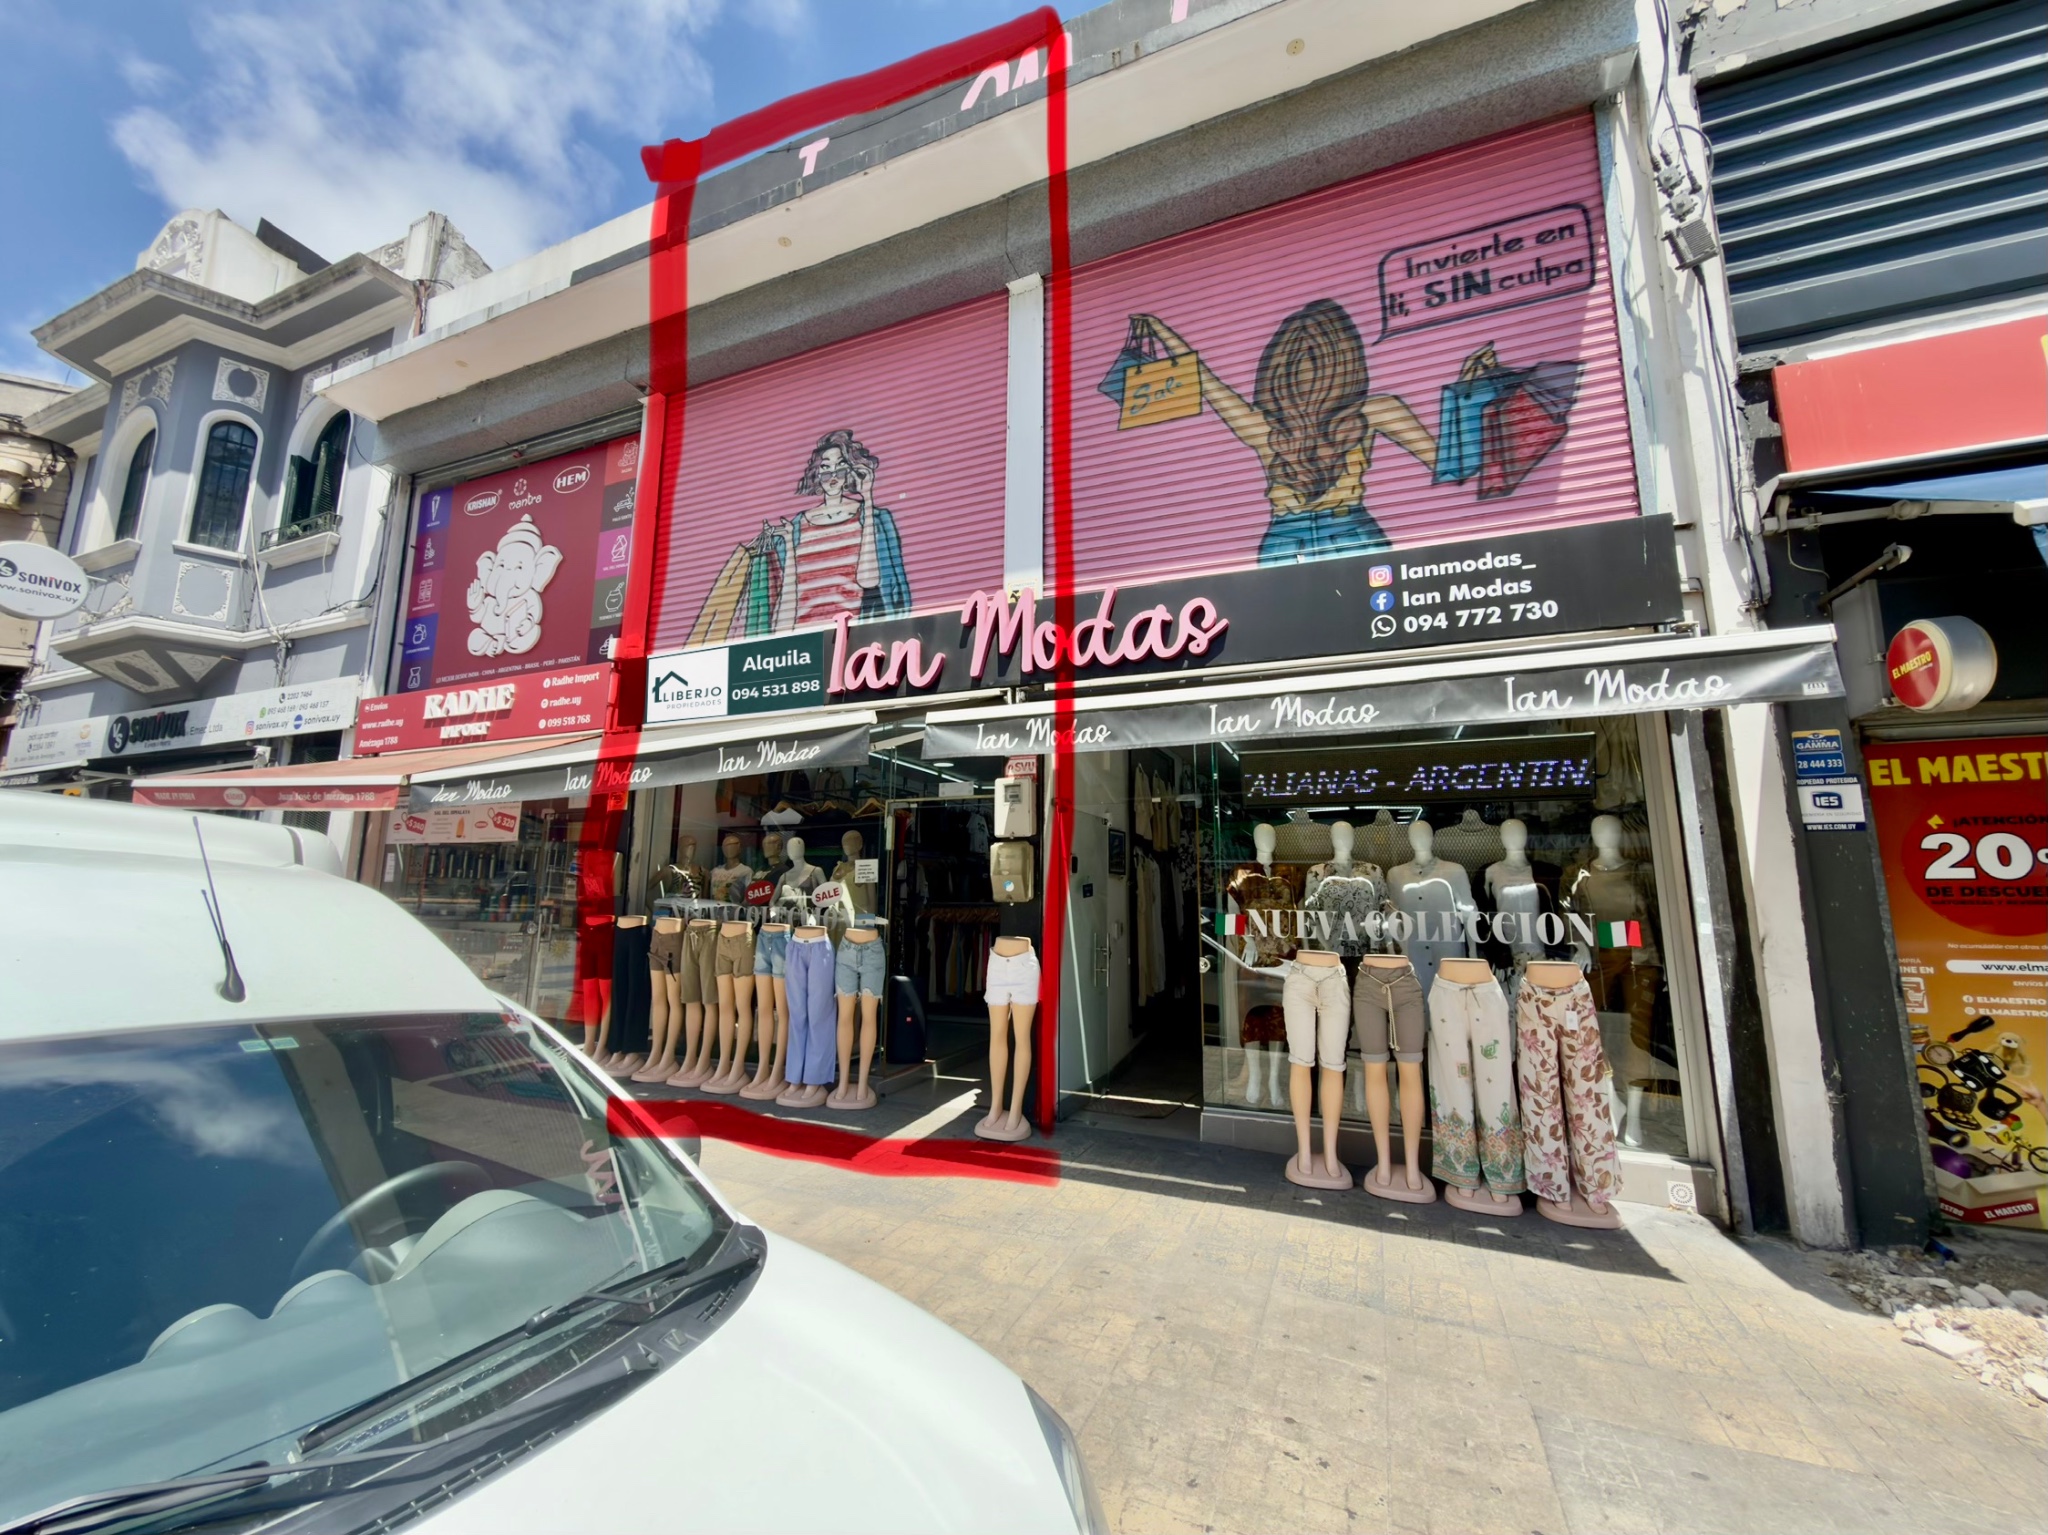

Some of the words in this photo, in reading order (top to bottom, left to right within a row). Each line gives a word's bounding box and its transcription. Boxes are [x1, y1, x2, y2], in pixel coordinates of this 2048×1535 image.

[1407, 232, 1524, 278] Invierte
[1535, 224, 1575, 244] en
[1388, 292, 1410, 317] ti,
[1424, 268, 1492, 307] SIN
[1498, 257, 1585, 286] culpa
[556, 471, 587, 489] HEM
[467, 496, 497, 511] KRISHAN
[508, 493, 542, 510] mantra
[1400, 552, 1537, 580] Ianmodas_
[18, 571, 81, 593] SONIVOX
[1402, 591, 1441, 607] Ian
[1449, 578, 1533, 602] Modas
[1404, 612, 1448, 633] 094
[1455, 606, 1502, 627] 772
[1510, 600, 1559, 621] 730
[826, 611, 946, 694] Ian
[961, 586, 1230, 678] Modas
[498, 665, 522, 673] ARGENTINA
[525, 662, 540, 670] BRASIL
[742, 649, 812, 672] Alquila
[1892, 668, 1901, 679] EL
[1901, 651, 1932, 675] MAESTRO
[552, 673, 574, 686] Radhe
[575, 671, 600, 685] Import
[663, 686, 722, 702] LIBERJO
[732, 687, 759, 700] 094
[762, 684, 788, 697] 531
[791, 680, 820, 694] 898
[1504, 676, 1573, 713] Ian
[1585, 668, 1731, 707] Modas
[423, 683, 515, 719] RADHE
[549, 696, 581, 707] radhe.uy
[666, 699, 722, 710] PROPIEDADES
[255, 720, 289, 731] sonivox.uy
[304, 714, 341, 725] sonivox.uy
[547, 717, 561, 728] 099
[562, 715, 575, 726] 518
[576, 714, 591, 725] 768
[1209, 704, 1260, 735] Ian
[1270, 696, 1380, 729] Modas
[439, 722, 491, 739] IMPORT
[975, 723, 1019, 750] Ian
[1025, 718, 1111, 748] Modas
[1796, 741, 1839, 749] GAMMA
[717, 747, 751, 773] Ian
[757, 740, 821, 768] Modas
[1798, 761, 1808, 769] 28
[1809, 760, 1825, 768] 444
[1827, 759, 1842, 767] 333
[563, 767, 593, 791] Ian
[596, 761, 653, 787] Modas
[1244, 769, 1379, 797] ALIANAS
[1404, 758, 1592, 791] ARGENTIN
[1869, 759, 1912, 786] EL
[1918, 752, 2048, 785] MAEST
[295, 789, 311, 801] José
[312, 790, 322, 800] de
[356, 791, 375, 801] 1788
[430, 783, 462, 802] Ian
[463, 780, 512, 801] Modas
[1815, 796, 1839, 806] IES
[501, 818, 515, 828] 320
[1806, 823, 1857, 831] WWW.IES.COM.UY
[747, 885, 771, 900] SALE
[815, 887, 840, 902] SALE
[1926, 887, 1954, 897] DE
[1246, 910, 1359, 939] NUEVA
[1369, 911, 1597, 948] COLECCION
[1976, 996, 2047, 1005] ELMAESTRO
[1984, 1207, 1995, 1218] EL
[1995, 1203, 2034, 1217] MAESTRO
